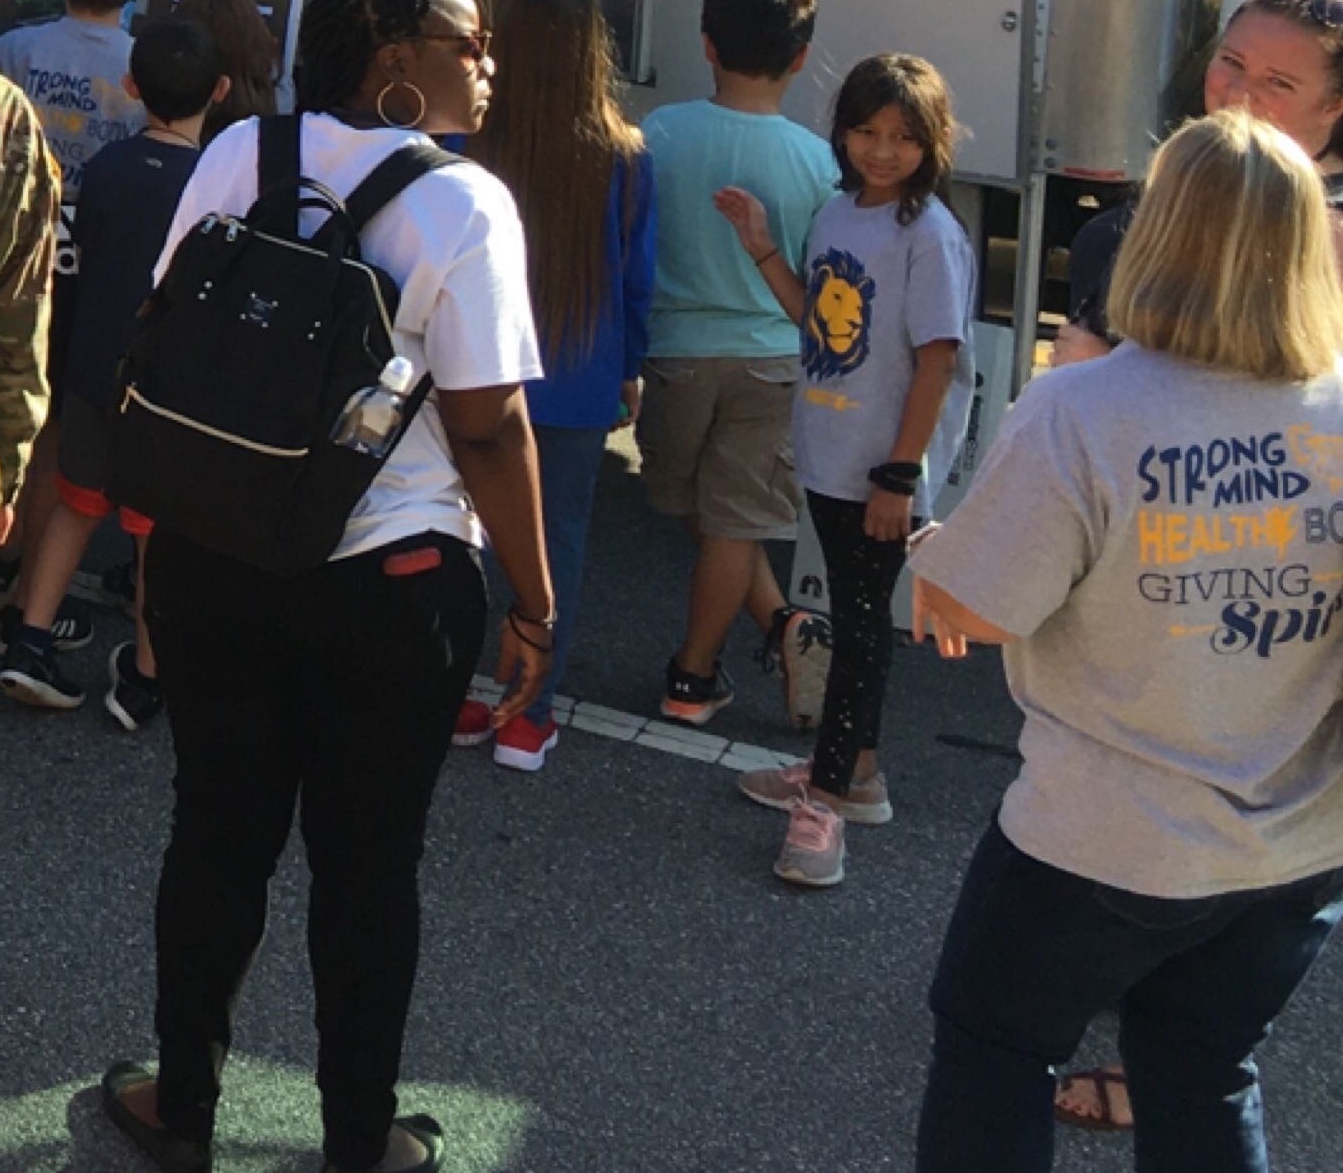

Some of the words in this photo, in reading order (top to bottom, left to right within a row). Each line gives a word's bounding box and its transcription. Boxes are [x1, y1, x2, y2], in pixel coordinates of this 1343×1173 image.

[47, 92, 97, 111] MIND
[1137, 431, 1287, 505] STRONG
[1213, 467, 1312, 508] MIND
[1137, 505, 1300, 565] HEALTHY
[1137, 564, 1312, 604] GIVING
